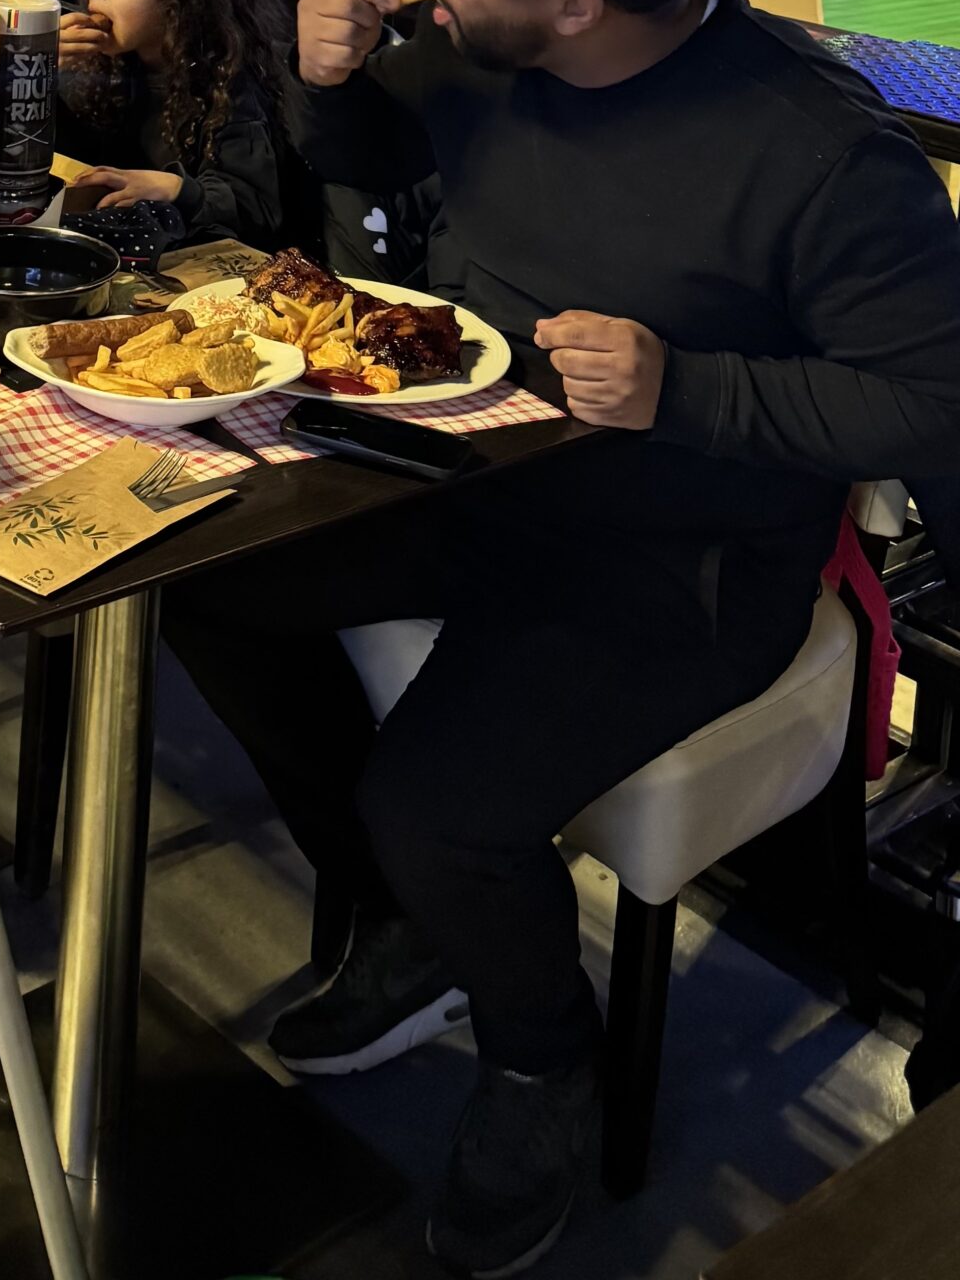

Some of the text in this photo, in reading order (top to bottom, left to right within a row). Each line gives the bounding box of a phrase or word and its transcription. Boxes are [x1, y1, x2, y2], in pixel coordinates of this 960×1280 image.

[13, 53, 47, 77] SA
[12, 78, 46, 100] MU
[10, 102, 45, 122] RAI
